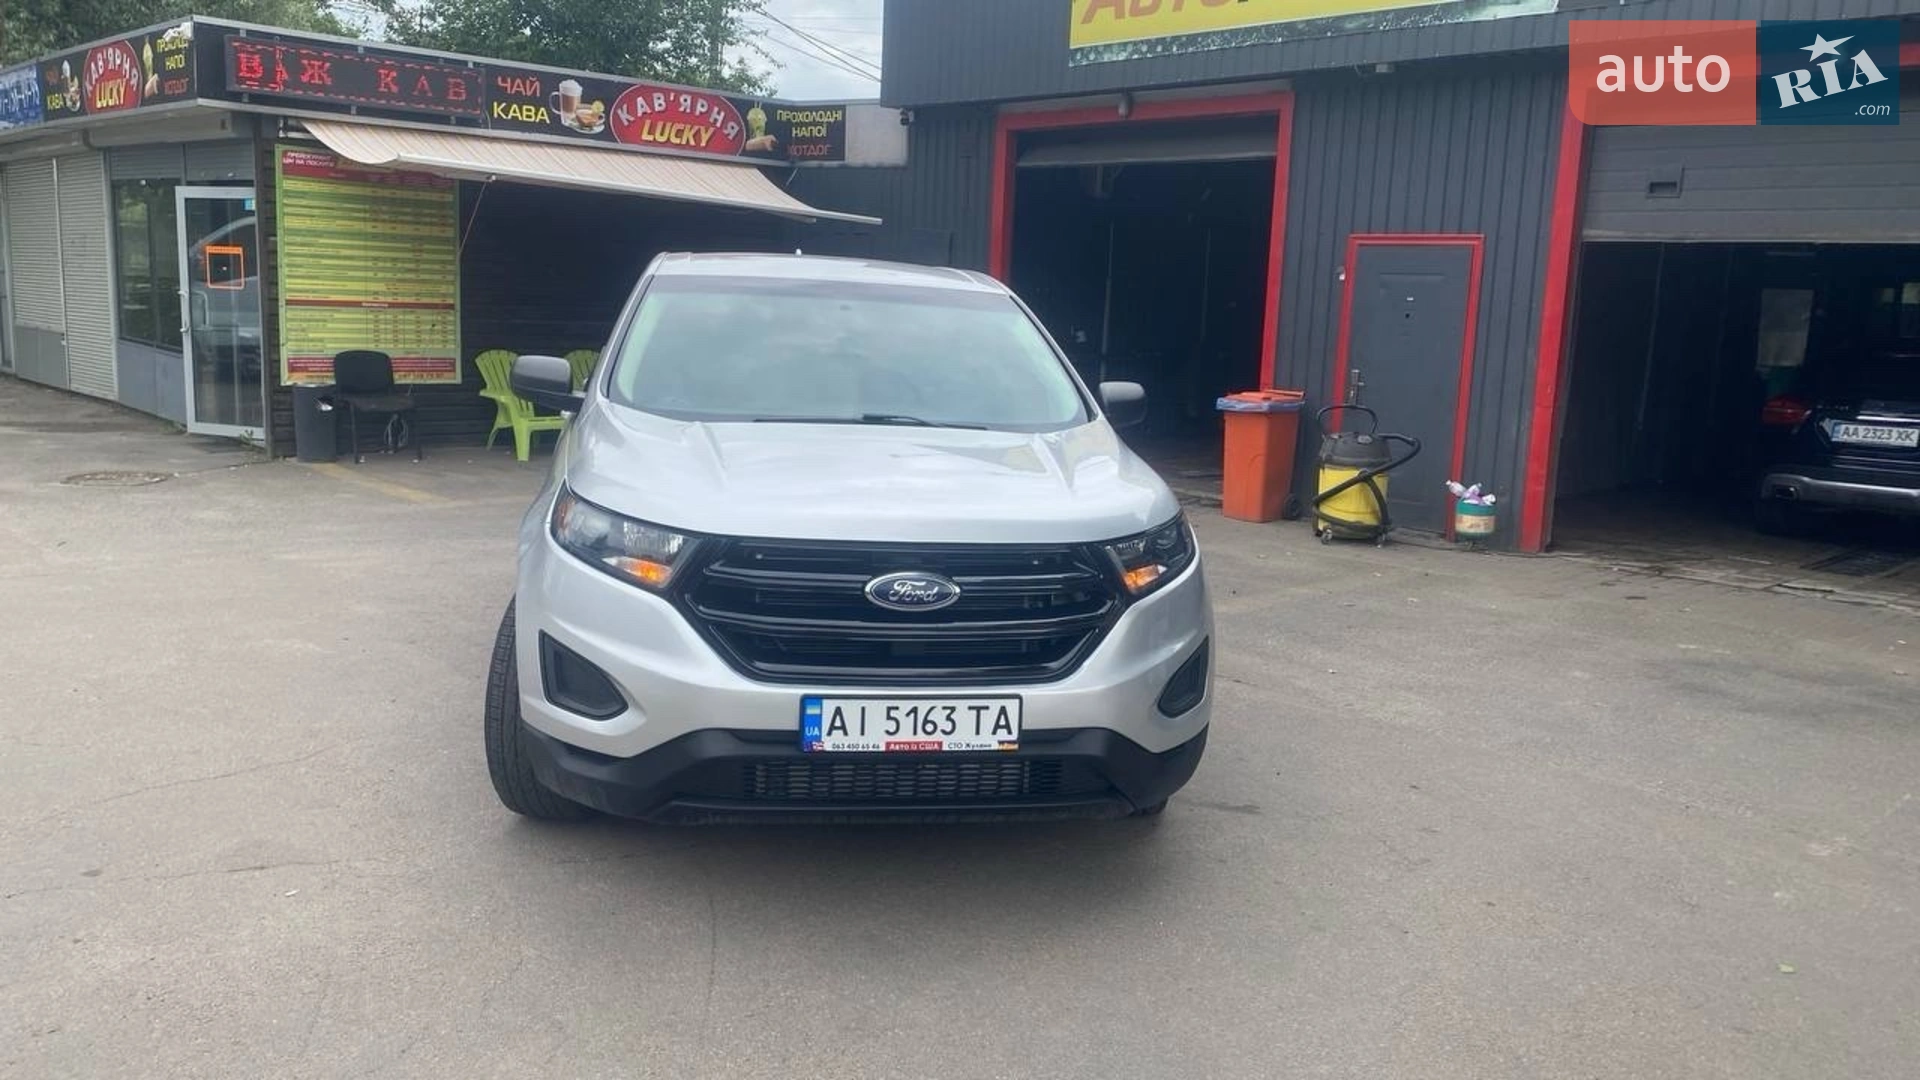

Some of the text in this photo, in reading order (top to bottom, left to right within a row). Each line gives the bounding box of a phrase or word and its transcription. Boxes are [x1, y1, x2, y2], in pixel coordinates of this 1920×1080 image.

[86, 46, 139, 97] КАВ'ЯРНЯ
[96, 79, 127, 109] LUCKY
[497, 76, 541, 97] ЧАЙ
[493, 101, 550, 124] КАВА
[617, 91, 740, 140] КАВ'ЯРНЯ
[776, 109, 842, 123] ПРОХОЛОДНІ
[641, 120, 716, 147] LUCKY
[791, 123, 827, 137] НАПОЇ
[1842, 425, 1860, 438] AA
[1862, 428, 1893, 440] 2323
[889, 580, 939, 602] Ford
[804, 726, 820, 736] UA
[826, 706, 1014, 736] AI 5163 TA
[889, 742, 909, 750] Авто
[919, 742, 939, 750] США
[948, 742, 963, 750] СТО
